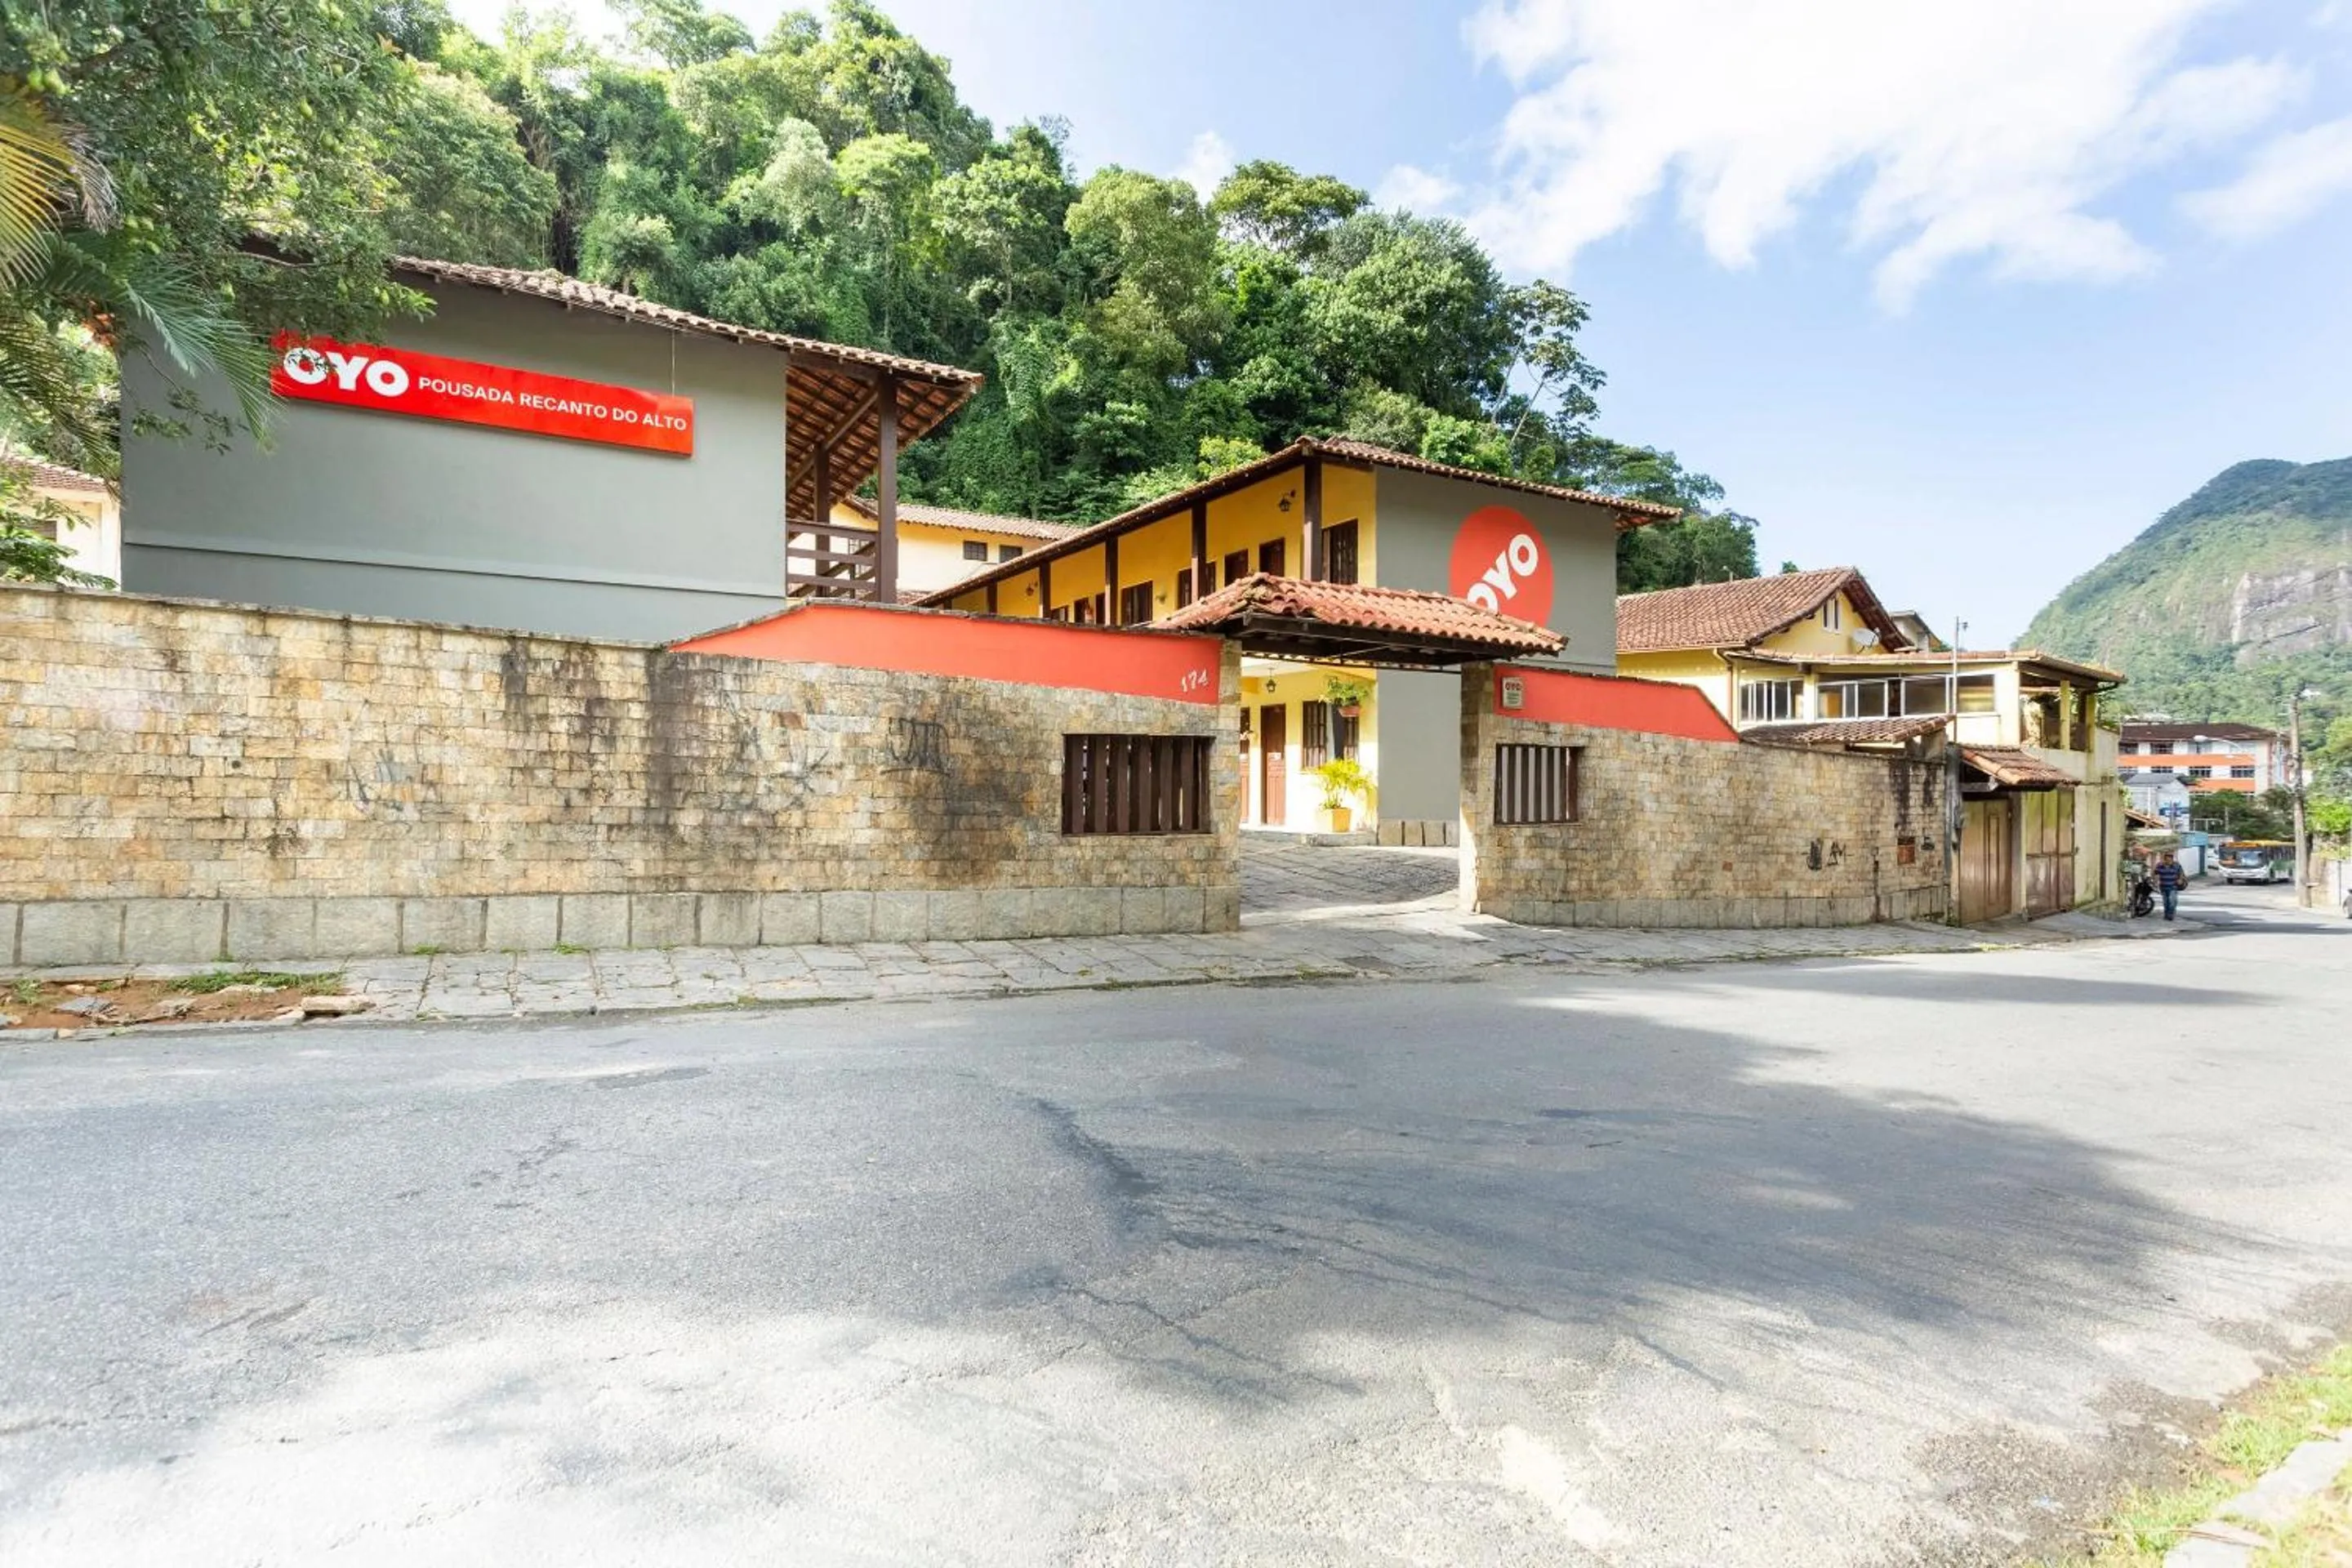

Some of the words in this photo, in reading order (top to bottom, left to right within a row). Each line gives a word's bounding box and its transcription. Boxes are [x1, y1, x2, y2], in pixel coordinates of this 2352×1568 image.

[283, 347, 409, 398] OYO
[418, 376, 514, 404] POUSADA
[519, 393, 608, 418] RECANTO
[612, 407, 638, 423] DO
[642, 412, 687, 431] ALTO
[1467, 533, 1539, 614] OYO
[1181, 667, 1209, 693] 174
